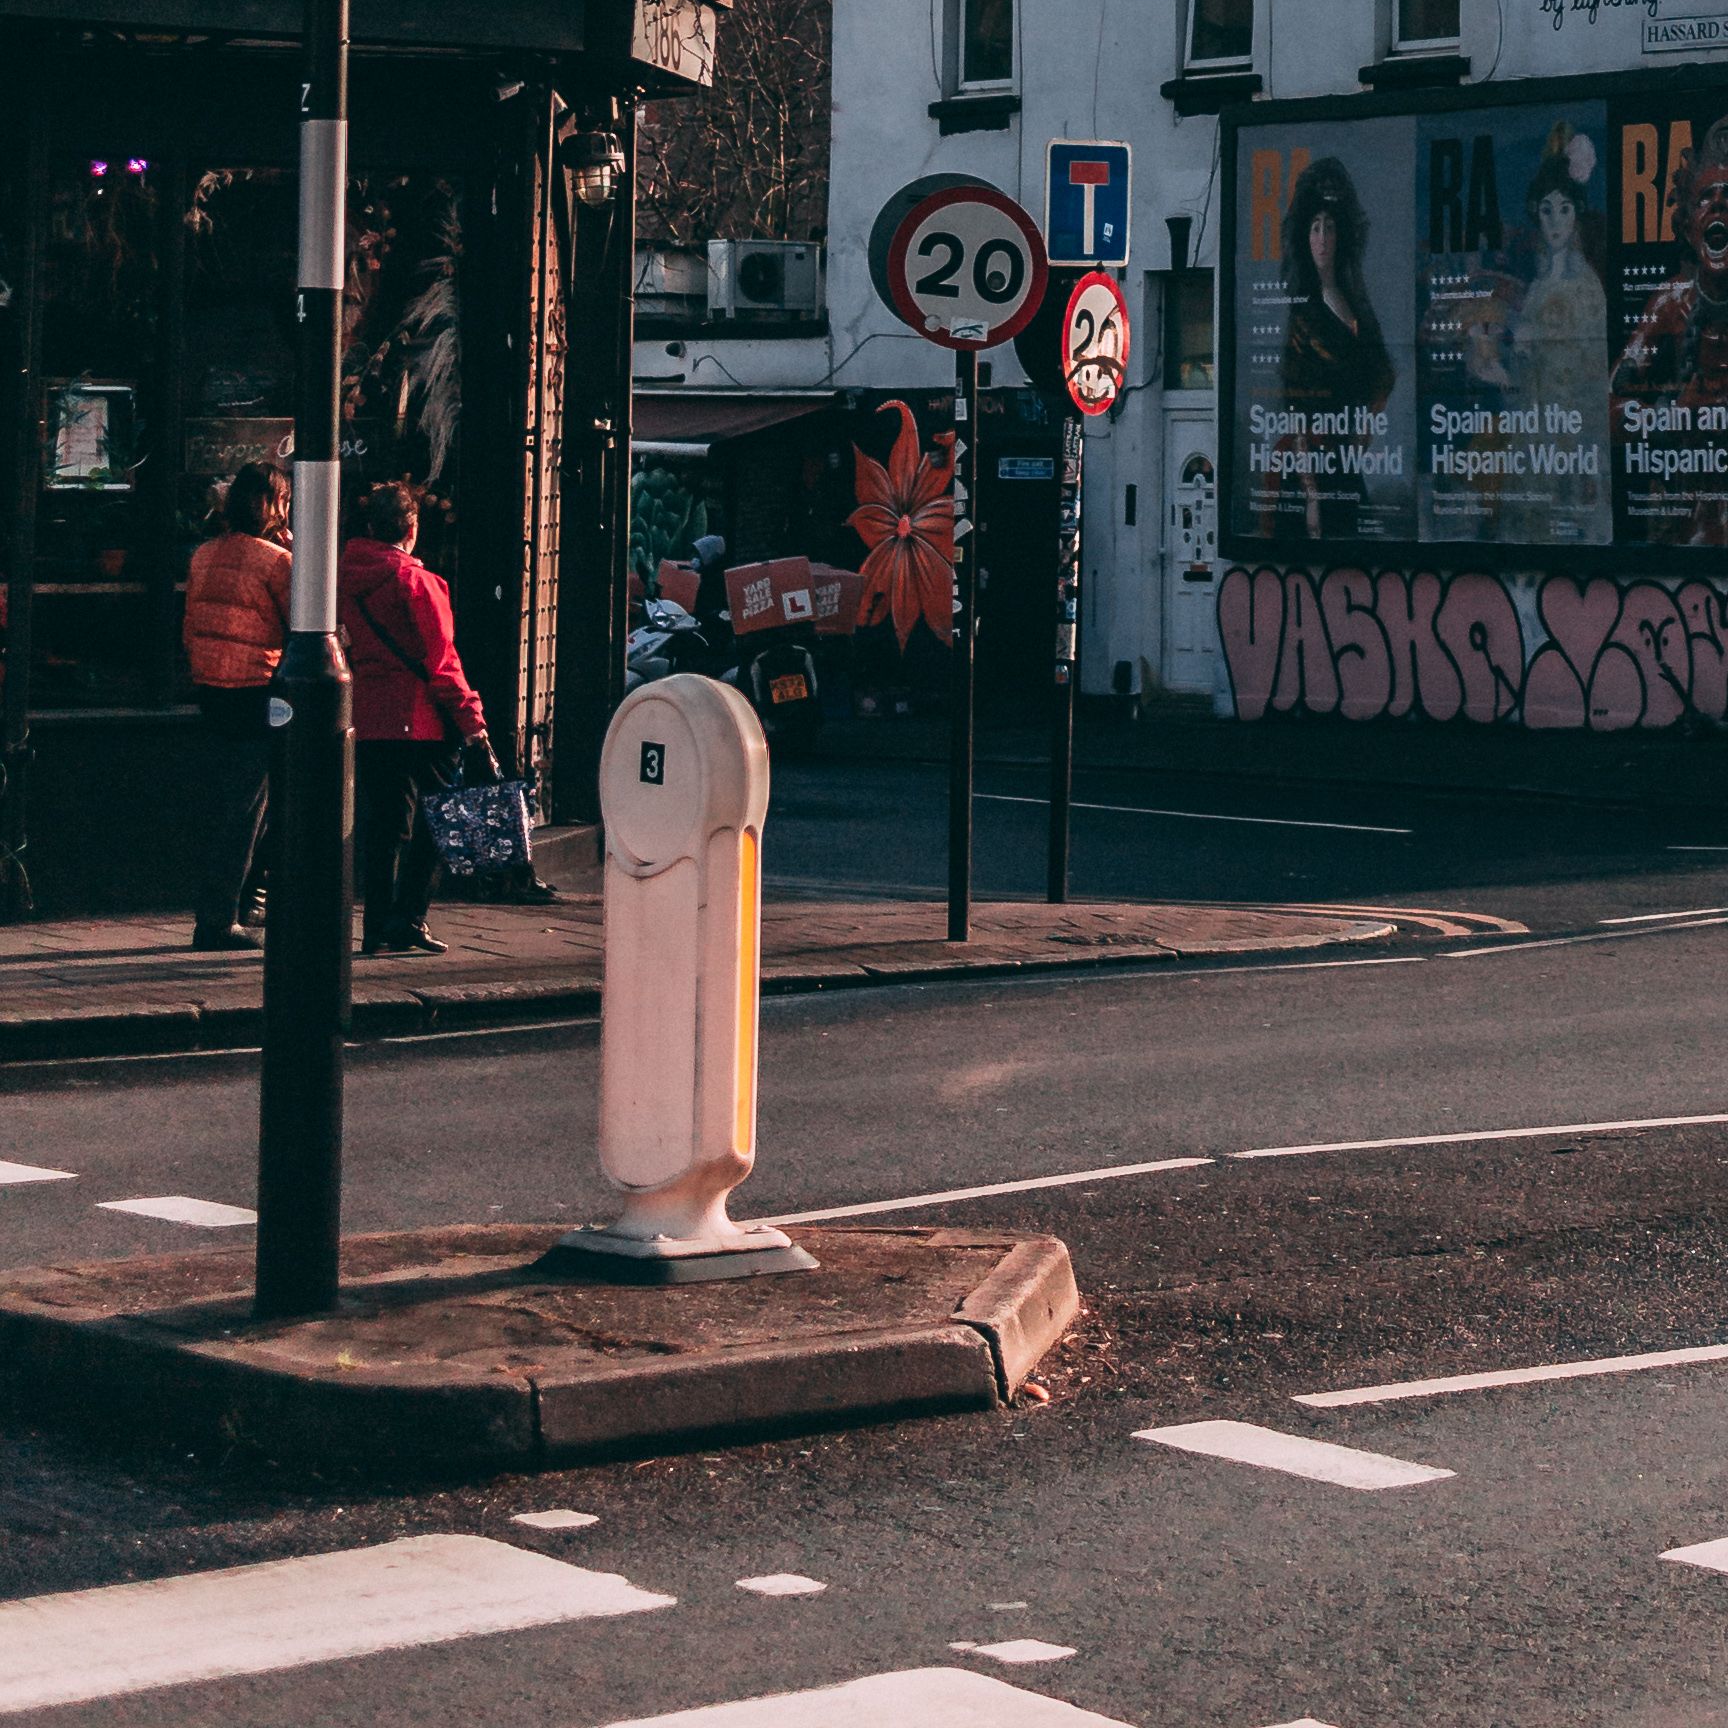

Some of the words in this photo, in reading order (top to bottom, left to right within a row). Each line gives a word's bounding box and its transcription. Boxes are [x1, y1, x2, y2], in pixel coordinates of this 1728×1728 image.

[1647, 20, 1721, 42] HASSARD
[301, 83, 311, 111] Z
[1430, 136, 1499, 253] RA
[915, 232, 1025, 304] 20
[297, 294, 307, 323] 4
[1250, 404, 1307, 440] Spain
[1312, 406, 1349, 435] and
[1355, 406, 1388, 435] the
[1430, 403, 1492, 440] Spain
[1499, 404, 1539, 433] and
[1544, 403, 1582, 434] the
[1623, 399, 1691, 438] Spain
[1250, 444, 1337, 479] Hispanic
[1340, 446, 1402, 475] World
[1432, 444, 1526, 481] Hispanic
[1529, 444, 1598, 475] World
[1625, 441, 1728, 480] Hispanic
[789, 597, 806, 612] L
[647, 750, 658, 778] 3
